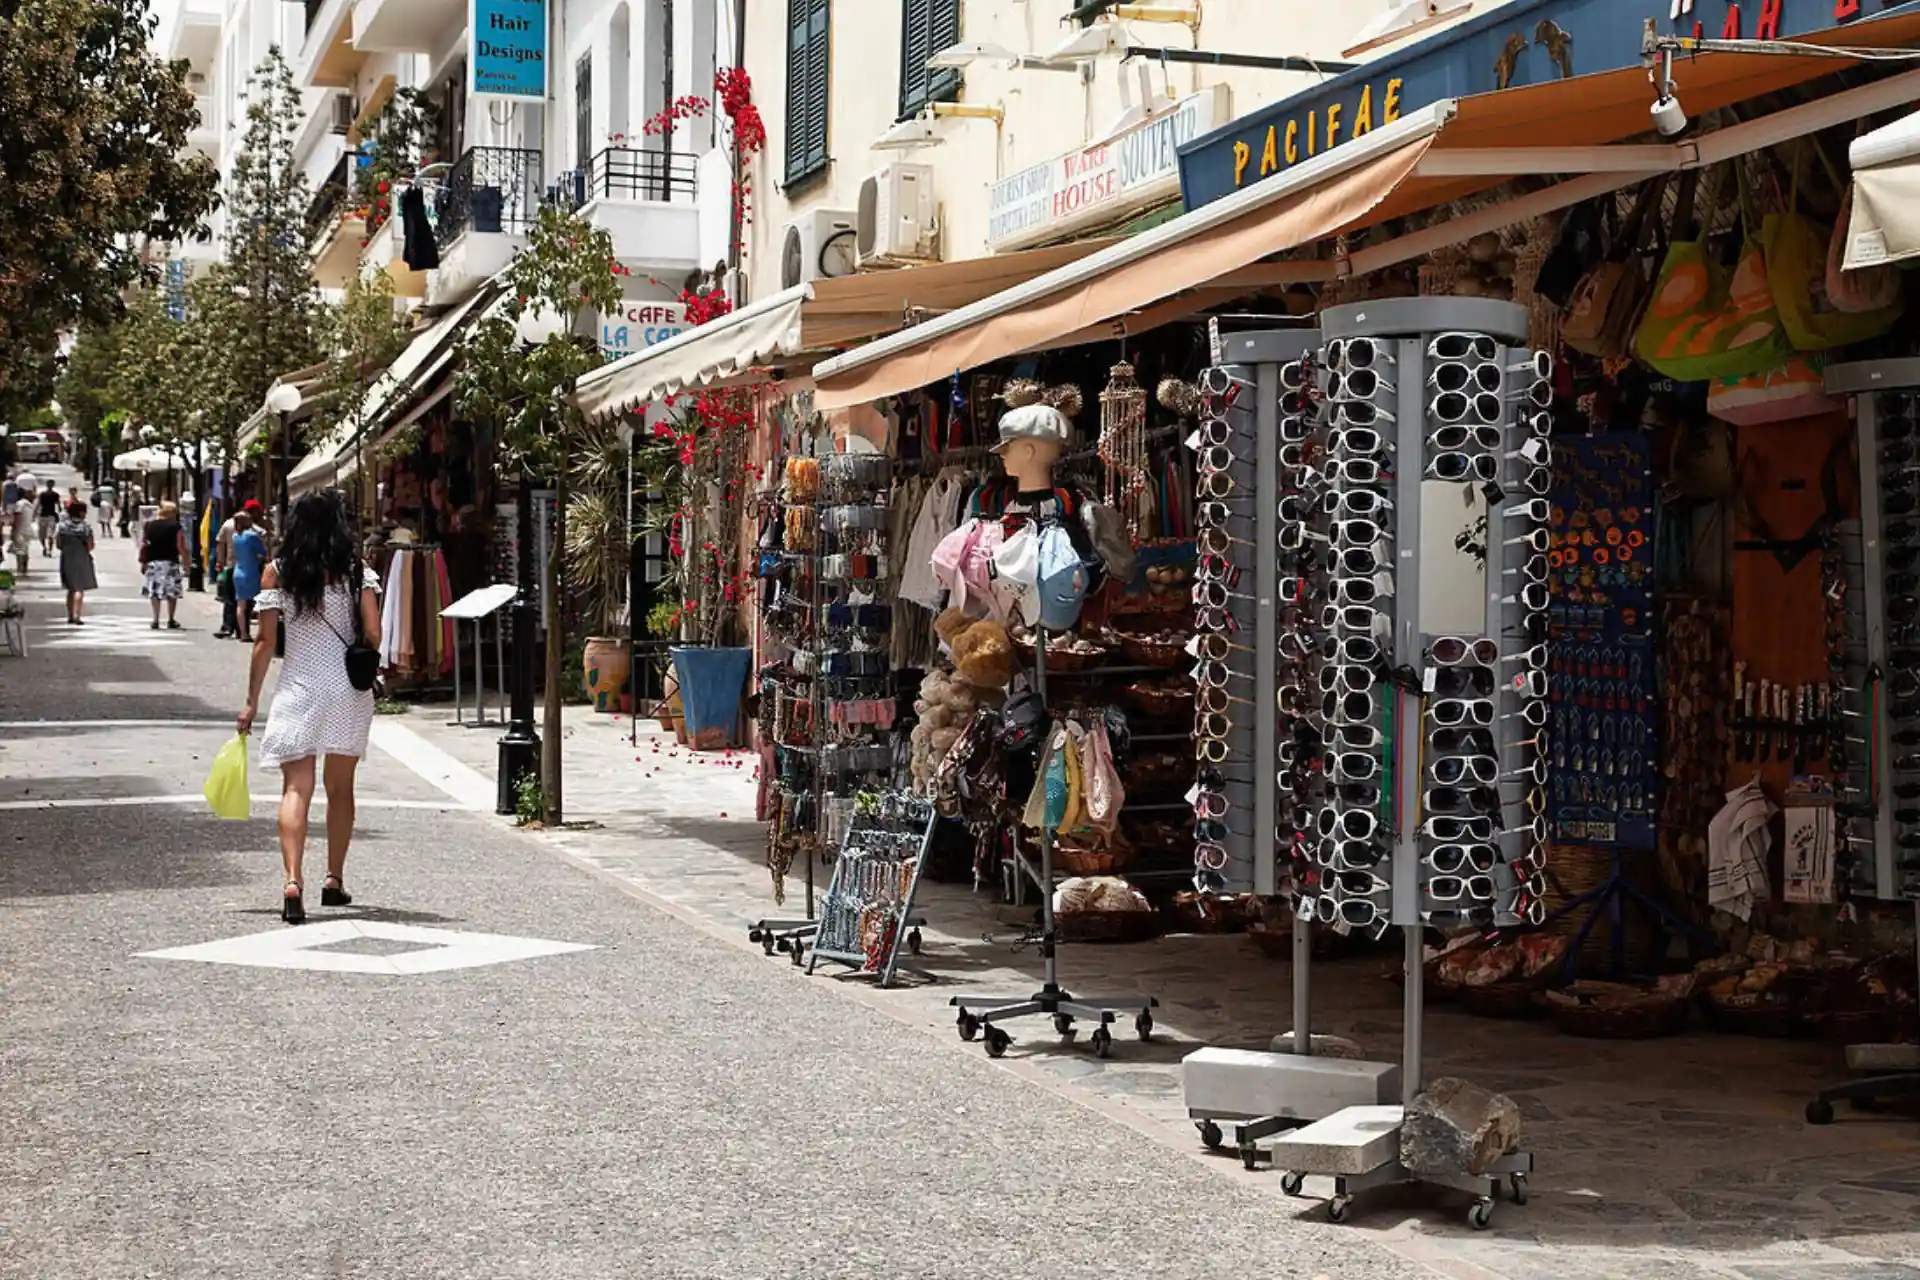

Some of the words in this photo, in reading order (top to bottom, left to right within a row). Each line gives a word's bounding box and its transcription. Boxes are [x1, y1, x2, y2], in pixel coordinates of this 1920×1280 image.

[488, 12, 532, 33] Hair
[477, 40, 543, 64] Designs
[1232, 77, 1403, 186] PACIFAE
[1052, 167, 1117, 217] HOUSE
[627, 306, 676, 324] CAFE
[603, 324, 628, 348] LA
